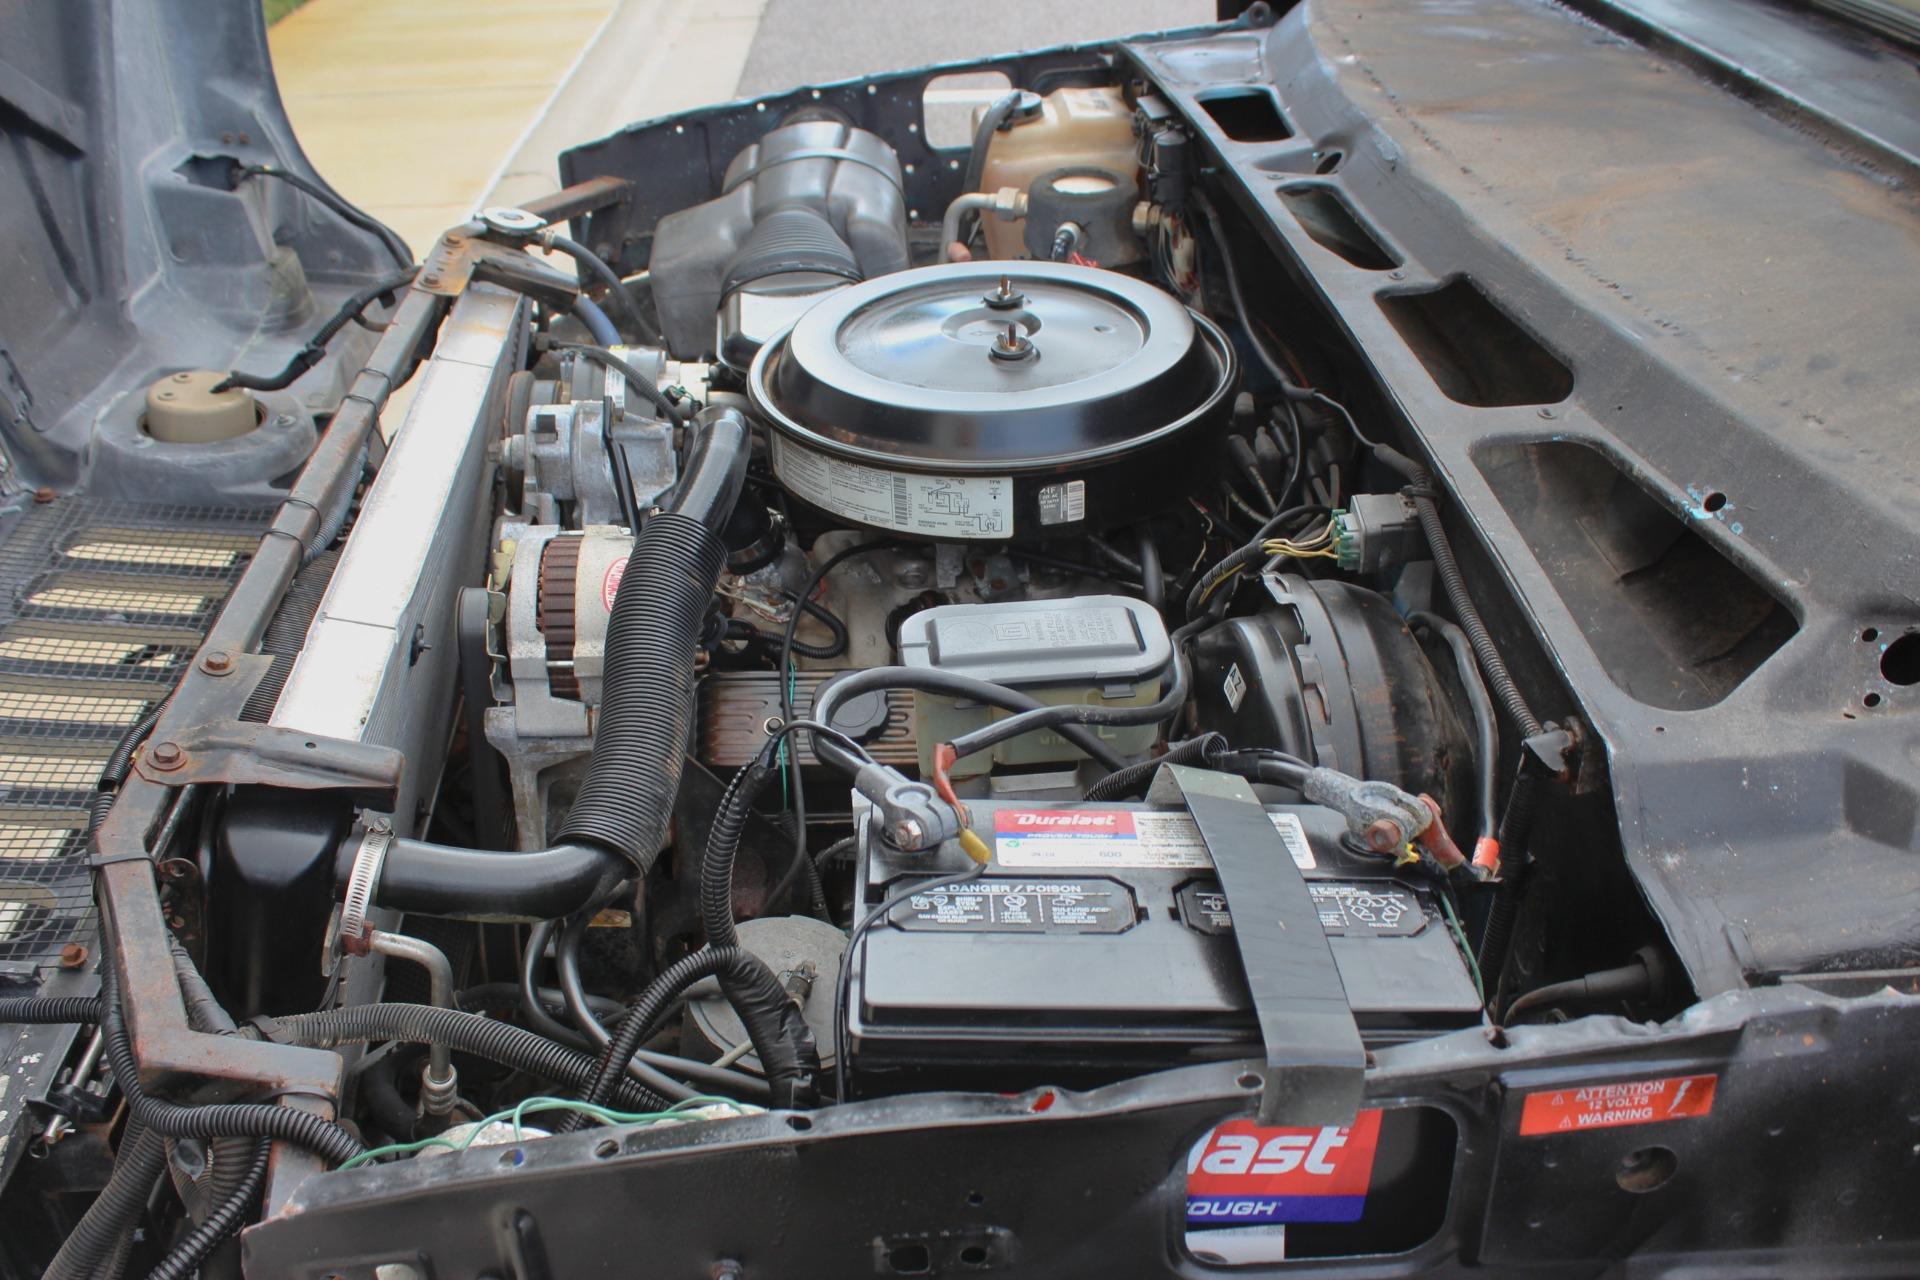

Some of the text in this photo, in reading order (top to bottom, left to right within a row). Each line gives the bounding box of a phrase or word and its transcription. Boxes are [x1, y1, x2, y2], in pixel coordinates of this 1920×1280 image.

[1014, 813, 1116, 826] Duralast
[949, 884, 1010, 893] DANGER
[1026, 884, 1081, 893] POISON
[1575, 1081, 1666, 1102] ATTENTION
[1589, 1095, 1649, 1110] 12 VOLTS
[1577, 1107, 1654, 1126] WARNING
[1186, 1201, 1278, 1216] OUGH
